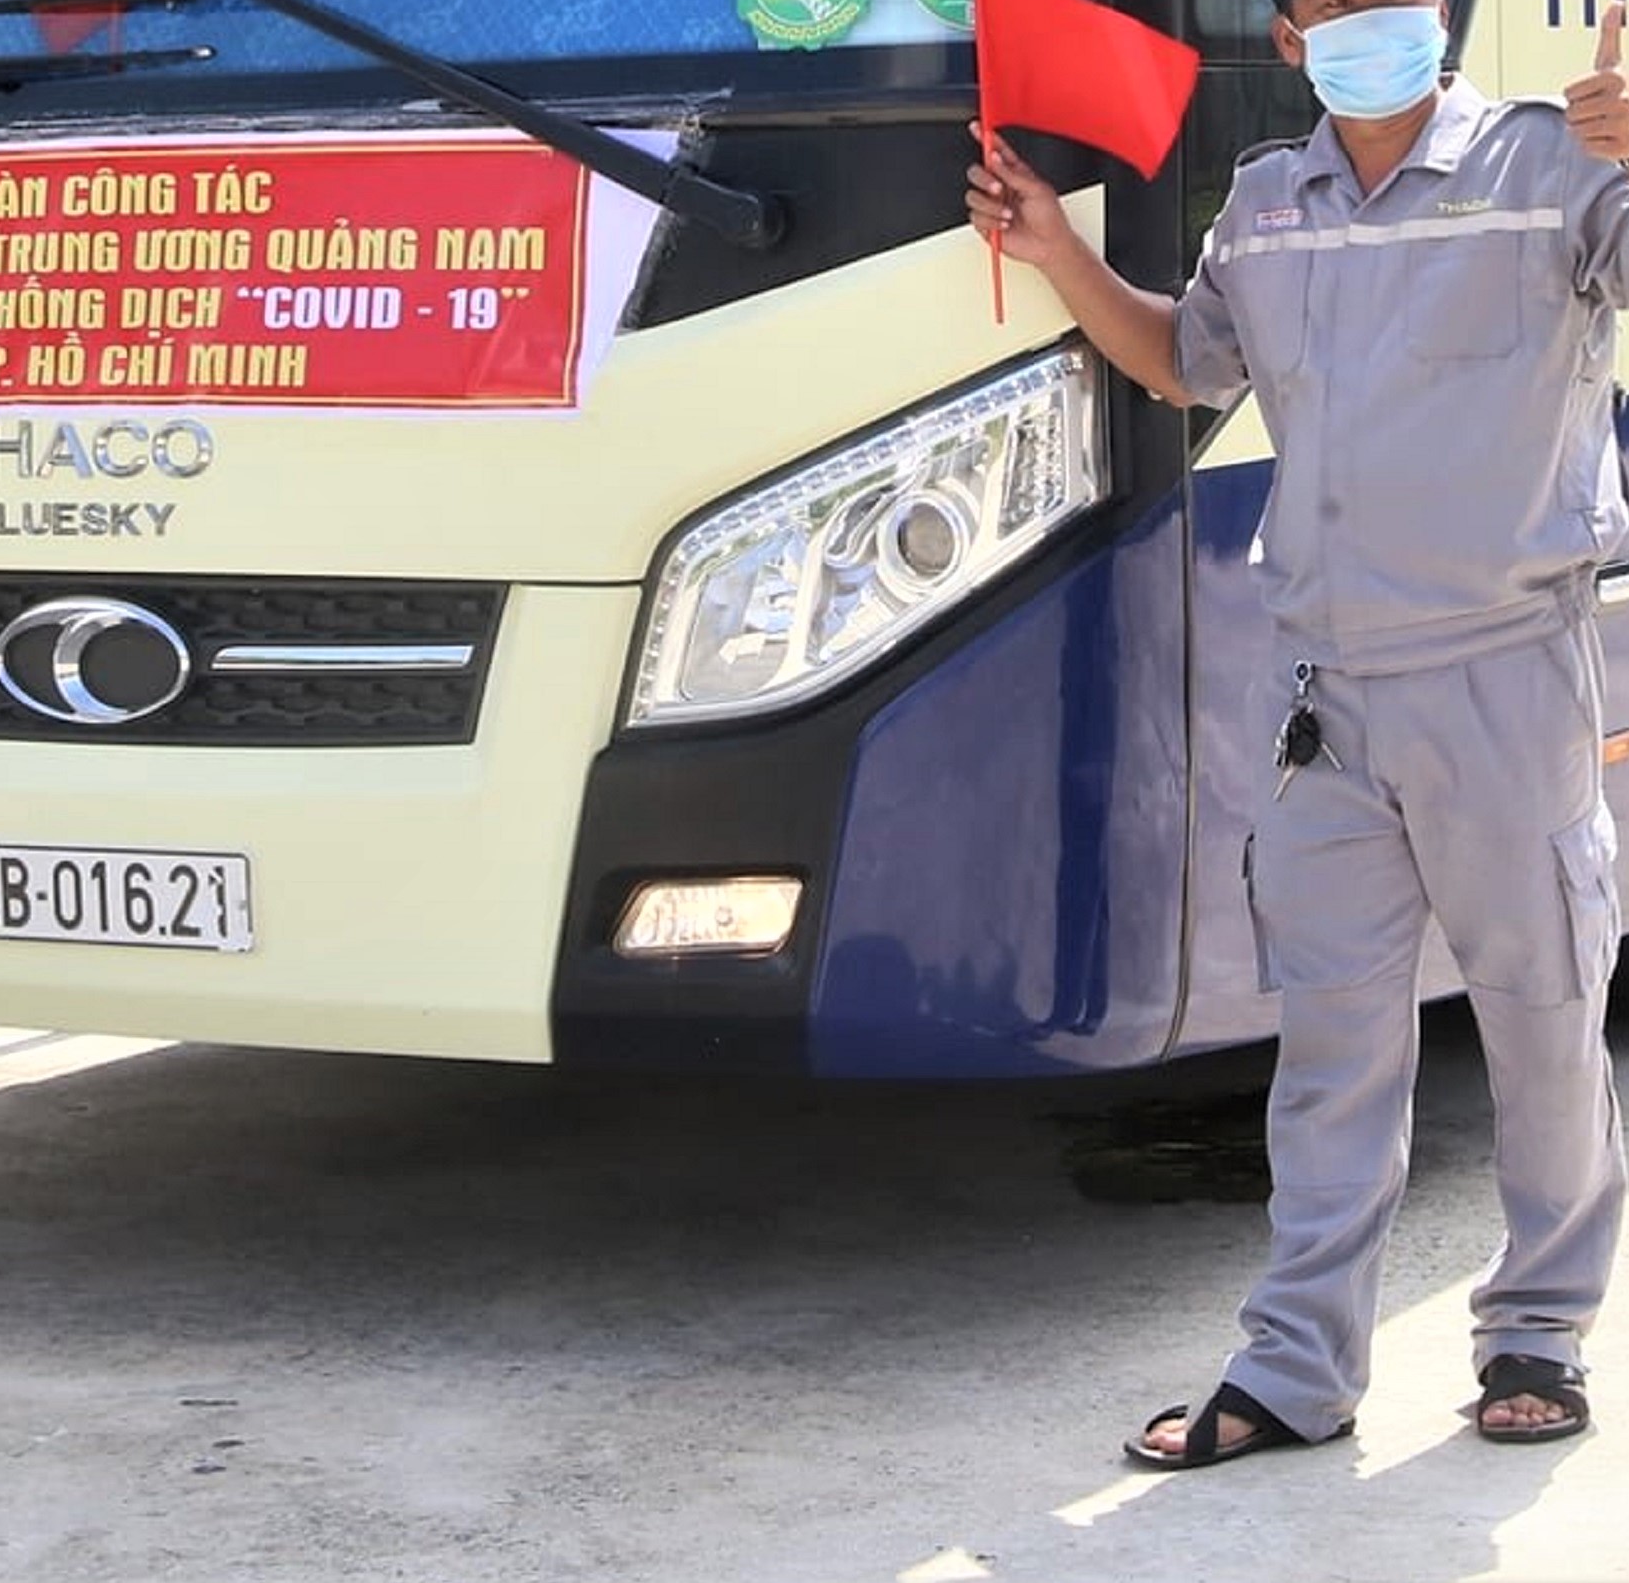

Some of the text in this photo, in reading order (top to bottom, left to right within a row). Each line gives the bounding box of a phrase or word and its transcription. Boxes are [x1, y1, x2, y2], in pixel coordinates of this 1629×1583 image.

[62, 167, 177, 219] CÔNG
[193, 164, 274, 215] TÁC
[134, 227, 252, 273] ƯƠNG
[266, 218, 419, 273] QUẢNG
[434, 227, 546, 271] NAM
[119, 286, 222, 338] DỊCH
[27, 330, 87, 387] HỒ
[99, 337, 175, 387] CHÍ
[186, 344, 309, 387] MINH
